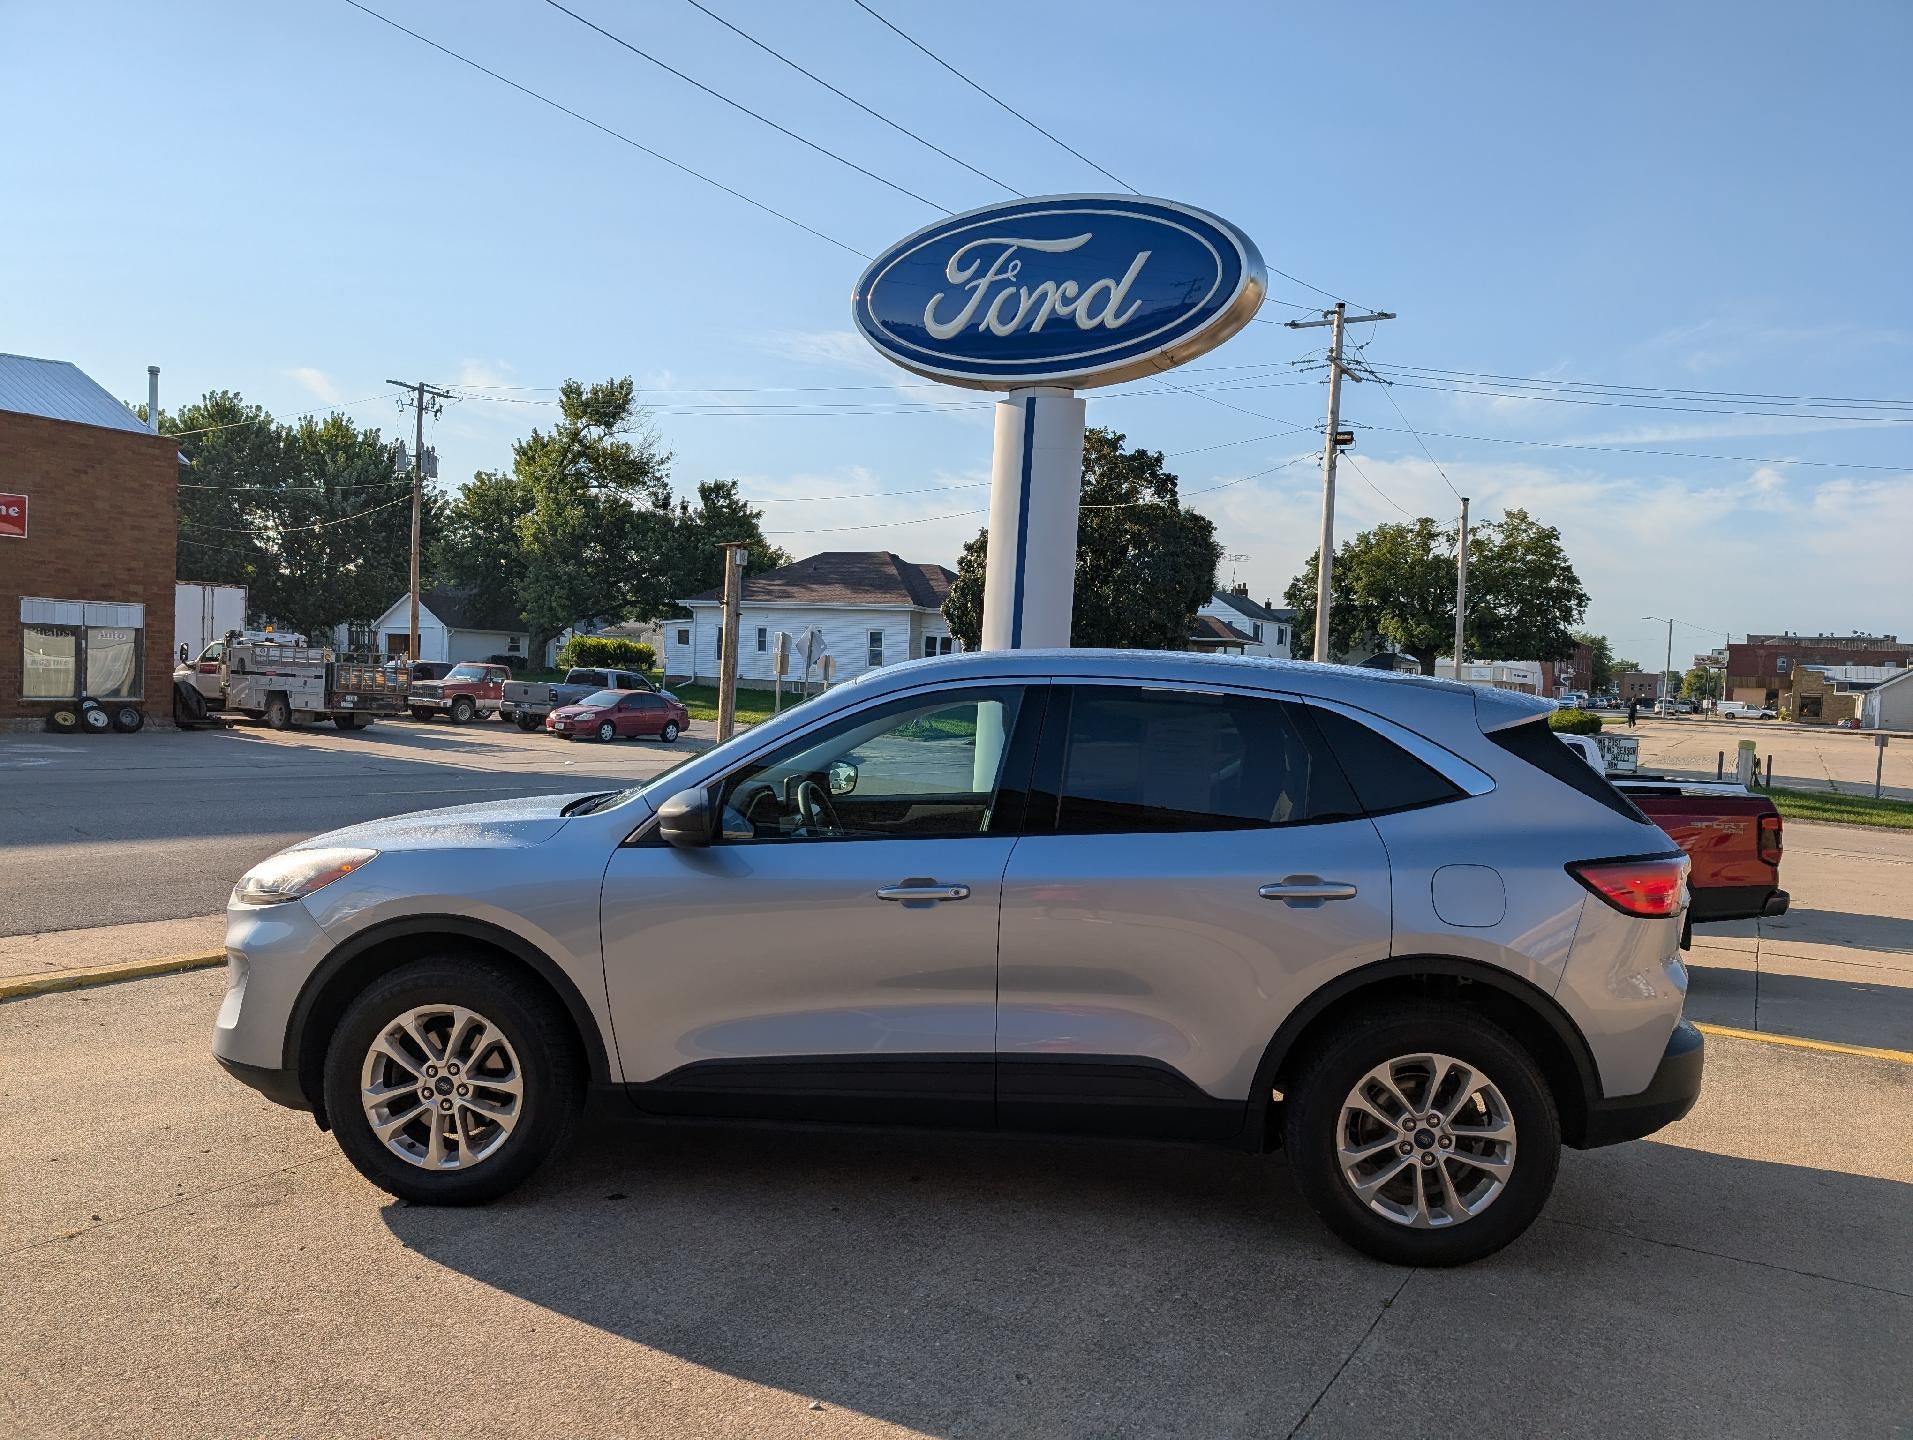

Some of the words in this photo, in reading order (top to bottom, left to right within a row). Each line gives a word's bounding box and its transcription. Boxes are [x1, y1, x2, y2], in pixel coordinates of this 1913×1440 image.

[924, 233, 1152, 339] Ford
[97, 630, 128, 640] Auto
[1616, 746, 1637, 756] SEASON
[1689, 821, 1748, 830] SPORT
